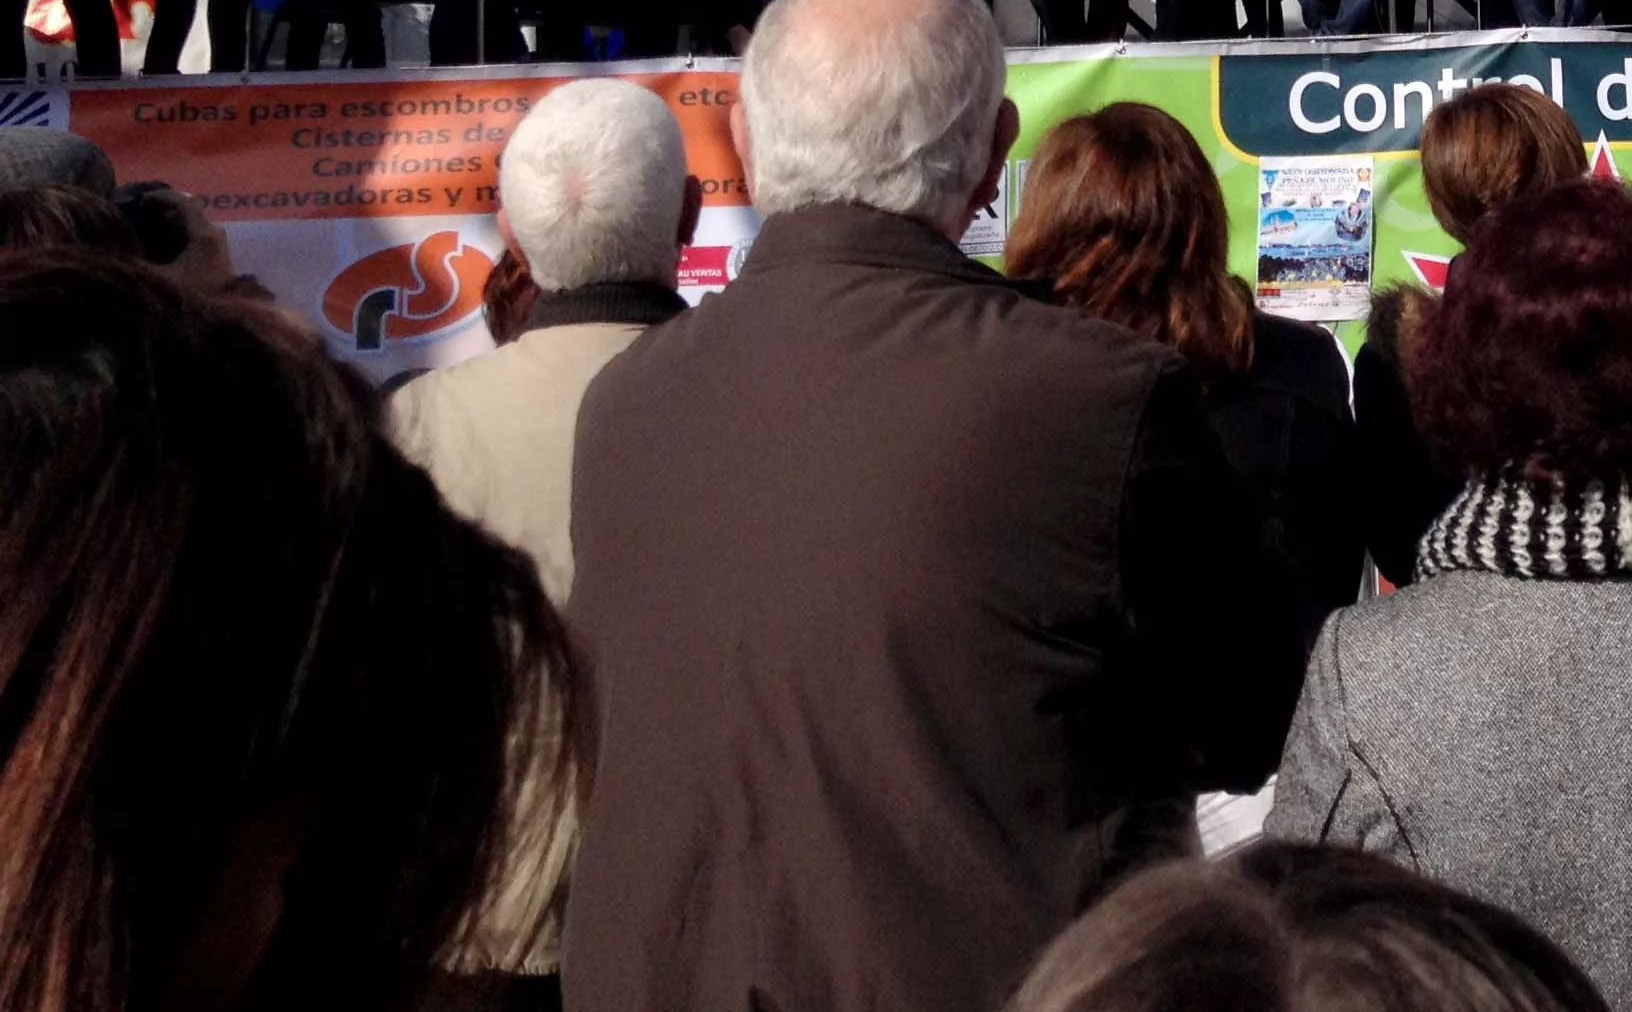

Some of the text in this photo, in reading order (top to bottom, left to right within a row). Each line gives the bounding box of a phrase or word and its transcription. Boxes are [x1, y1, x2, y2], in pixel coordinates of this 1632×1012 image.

[133, 100, 237, 125] Cubas
[249, 102, 328, 128] para
[339, 93, 529, 118] escombros
[291, 121, 505, 150] Cisternas de
[311, 153, 482, 178] Camiones
[442, 189, 462, 208] y
